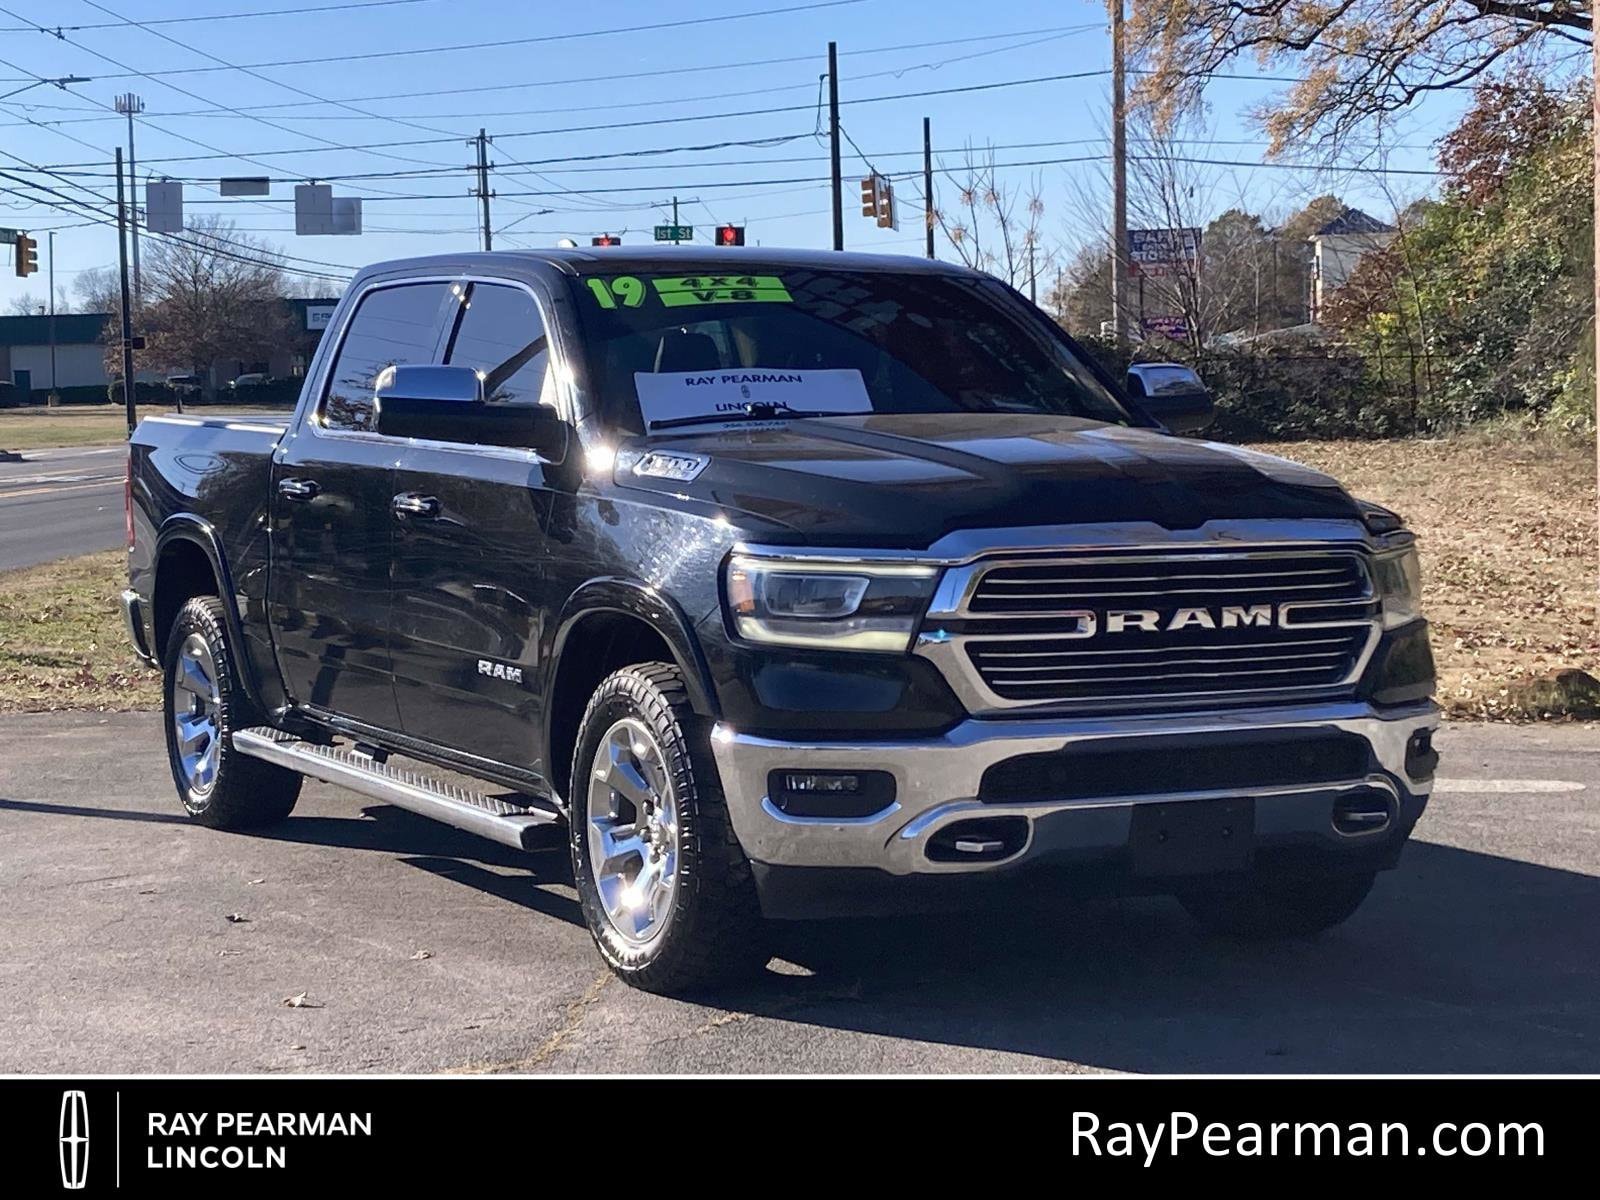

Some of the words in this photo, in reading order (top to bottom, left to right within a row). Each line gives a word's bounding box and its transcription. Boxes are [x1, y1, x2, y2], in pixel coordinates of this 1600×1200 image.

[678, 227, 691, 239] St
[586, 276, 646, 309] 19
[693, 290, 757, 302] V-8
[685, 375, 716, 386] RAY
[721, 374, 803, 384] PEARMAN
[1106, 604, 1272, 633] RAM
[477, 659, 523, 683] RAM
